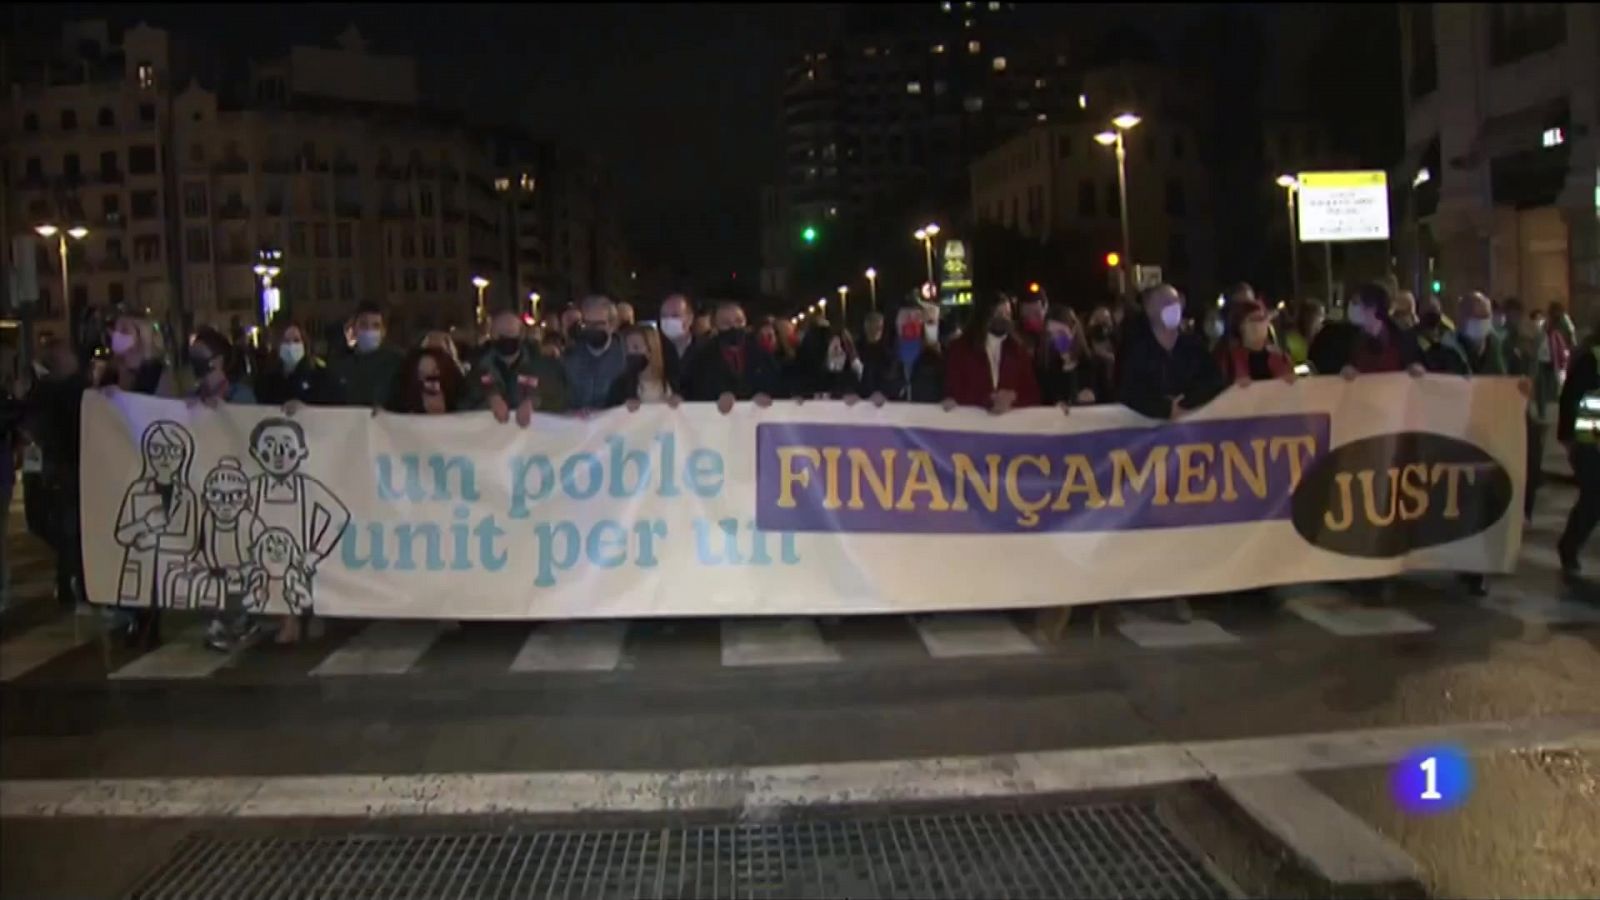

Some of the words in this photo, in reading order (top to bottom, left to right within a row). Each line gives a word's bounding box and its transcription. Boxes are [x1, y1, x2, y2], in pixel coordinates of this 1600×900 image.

[376, 451, 480, 500] un
[509, 432, 725, 518] poble
[777, 435, 1316, 527] FINANÇAMENT
[1324, 463, 1476, 532] JUST
[340, 507, 508, 571] unit
[534, 519, 667, 587] per
[693, 517, 801, 566] un
